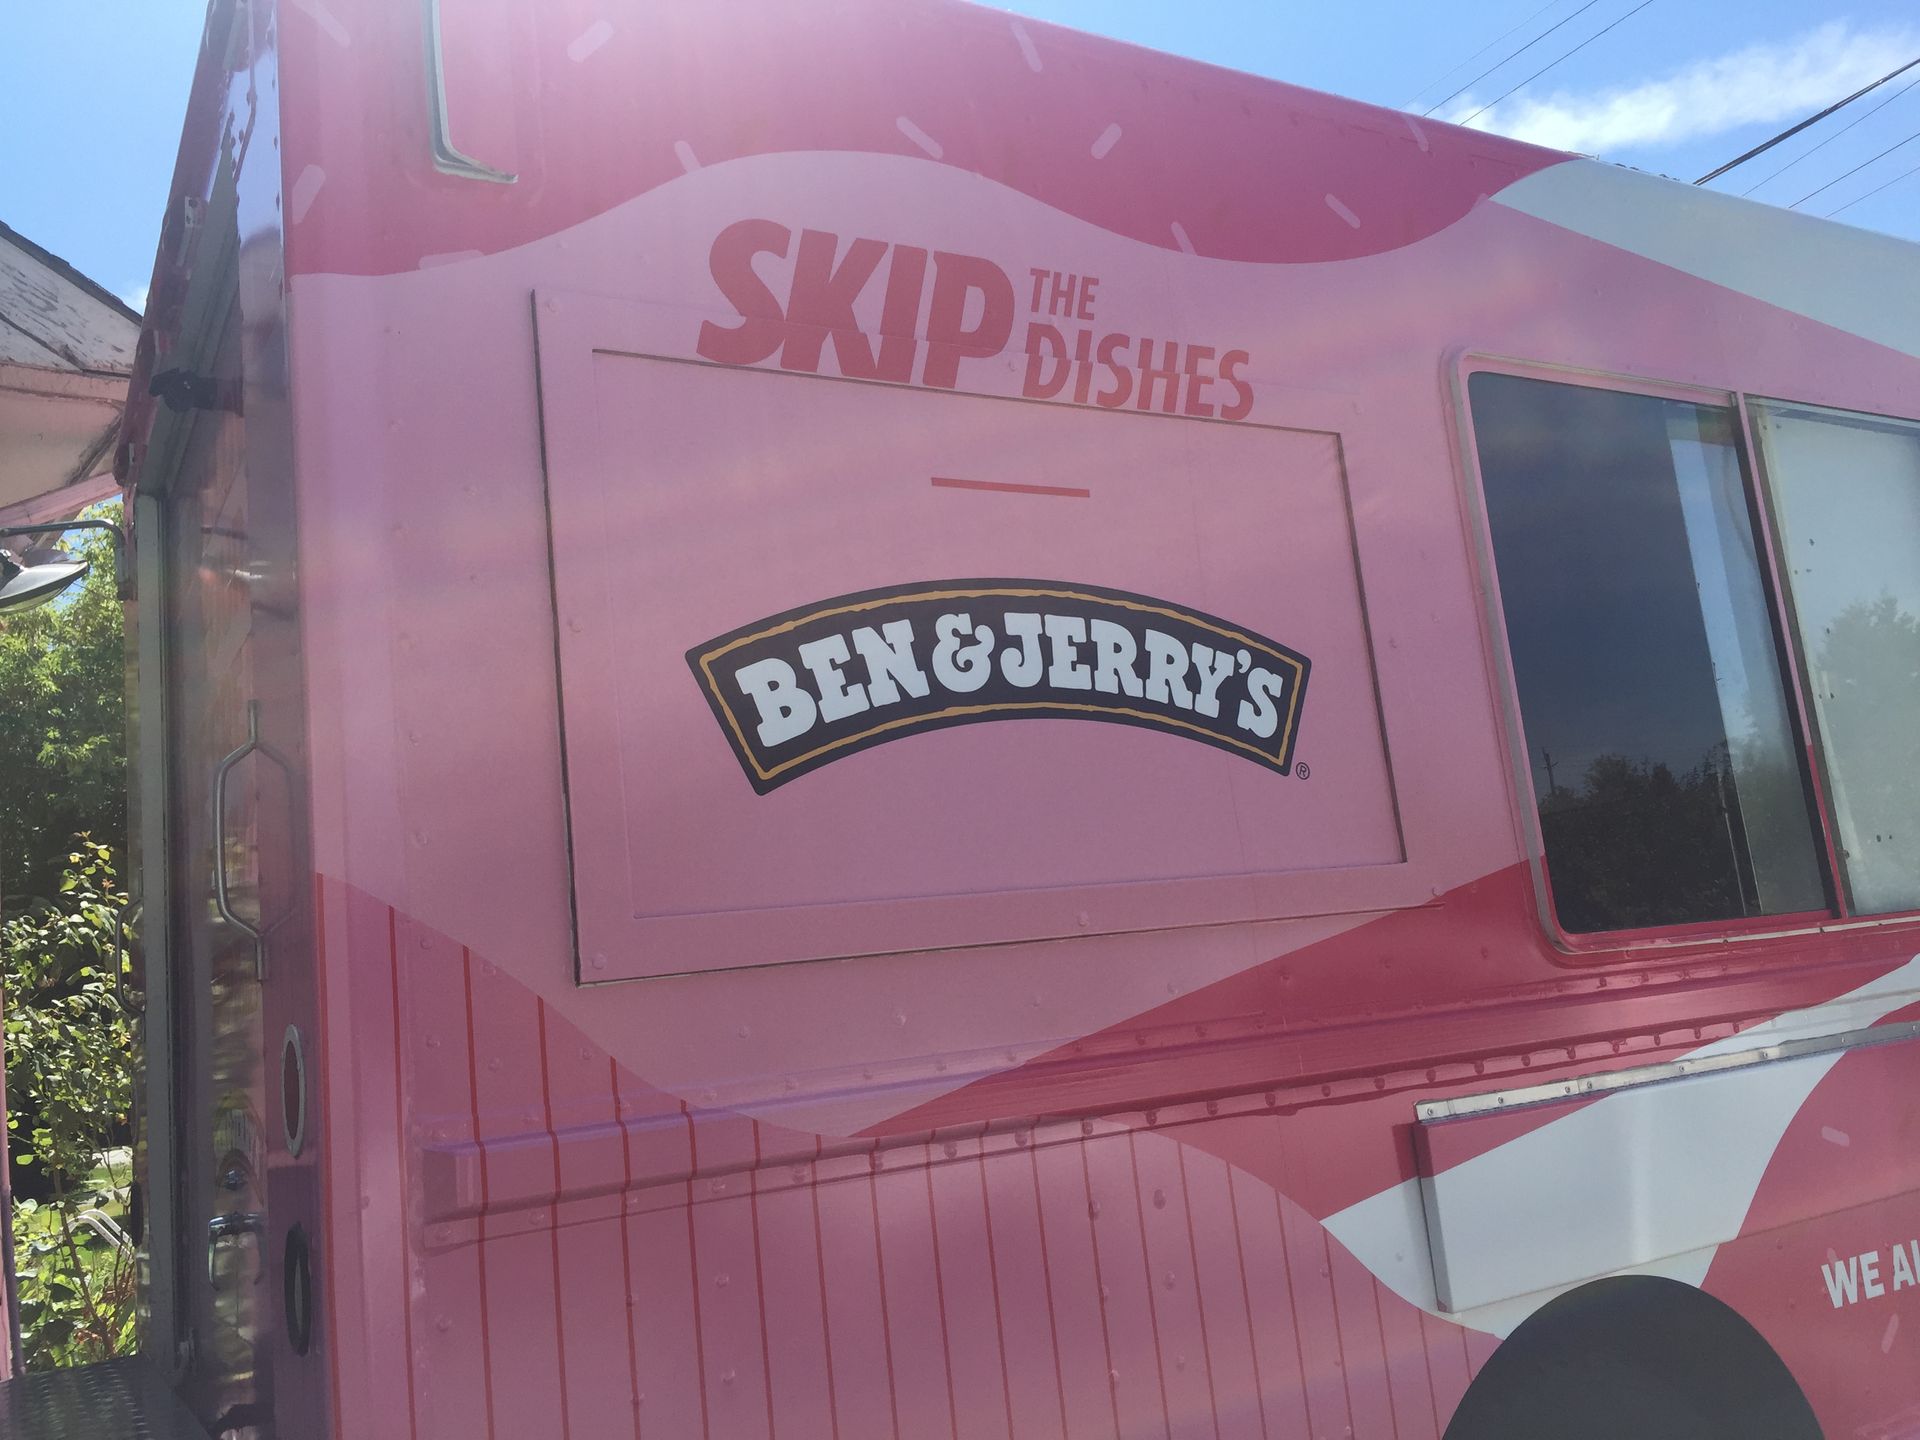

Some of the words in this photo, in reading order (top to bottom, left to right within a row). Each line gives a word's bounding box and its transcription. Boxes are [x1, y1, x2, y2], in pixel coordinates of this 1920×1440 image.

[696, 218, 1015, 389] SKIP
[1029, 268, 1100, 320] THE
[1021, 322, 1255, 421] DISHES
[735, 619, 930, 747] BEN
[932, 613, 996, 693] &
[1000, 612, 1284, 738] JERRY'S
[1821, 1250, 1885, 1309] WE
